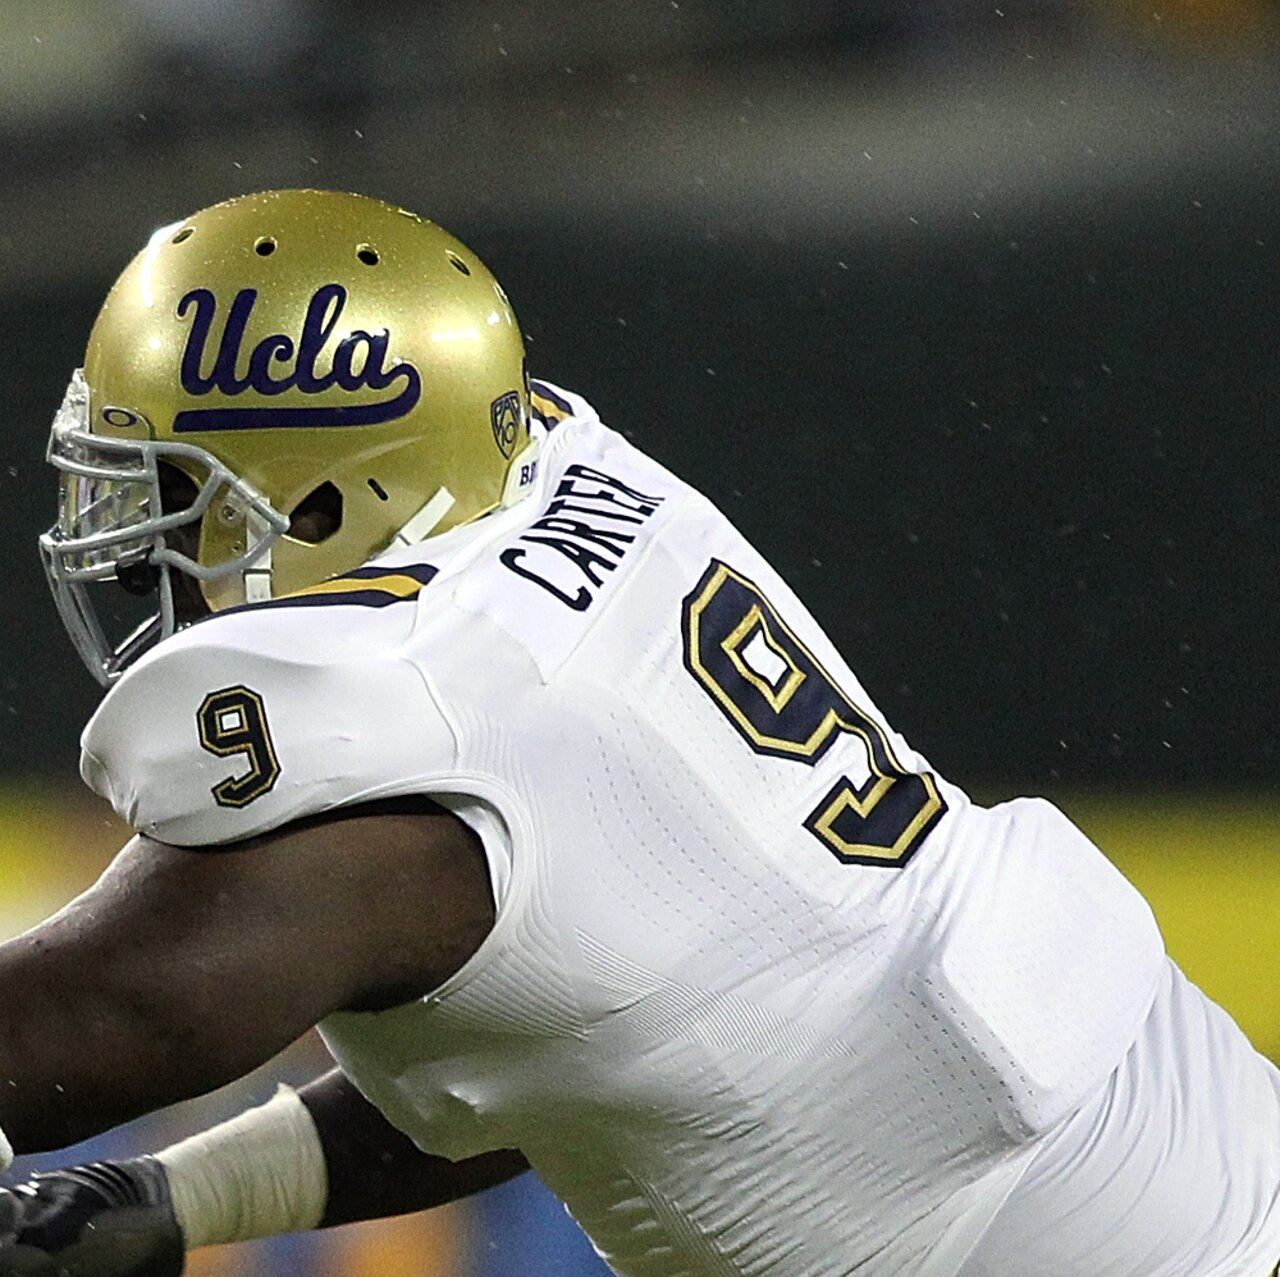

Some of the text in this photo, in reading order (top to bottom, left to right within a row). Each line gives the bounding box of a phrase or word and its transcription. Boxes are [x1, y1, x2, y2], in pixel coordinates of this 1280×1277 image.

[173, 283, 421, 432] Ucla
[499, 463, 666, 612] CARTER
[196, 684, 282, 809] 9
[681, 557, 949, 869] 9
